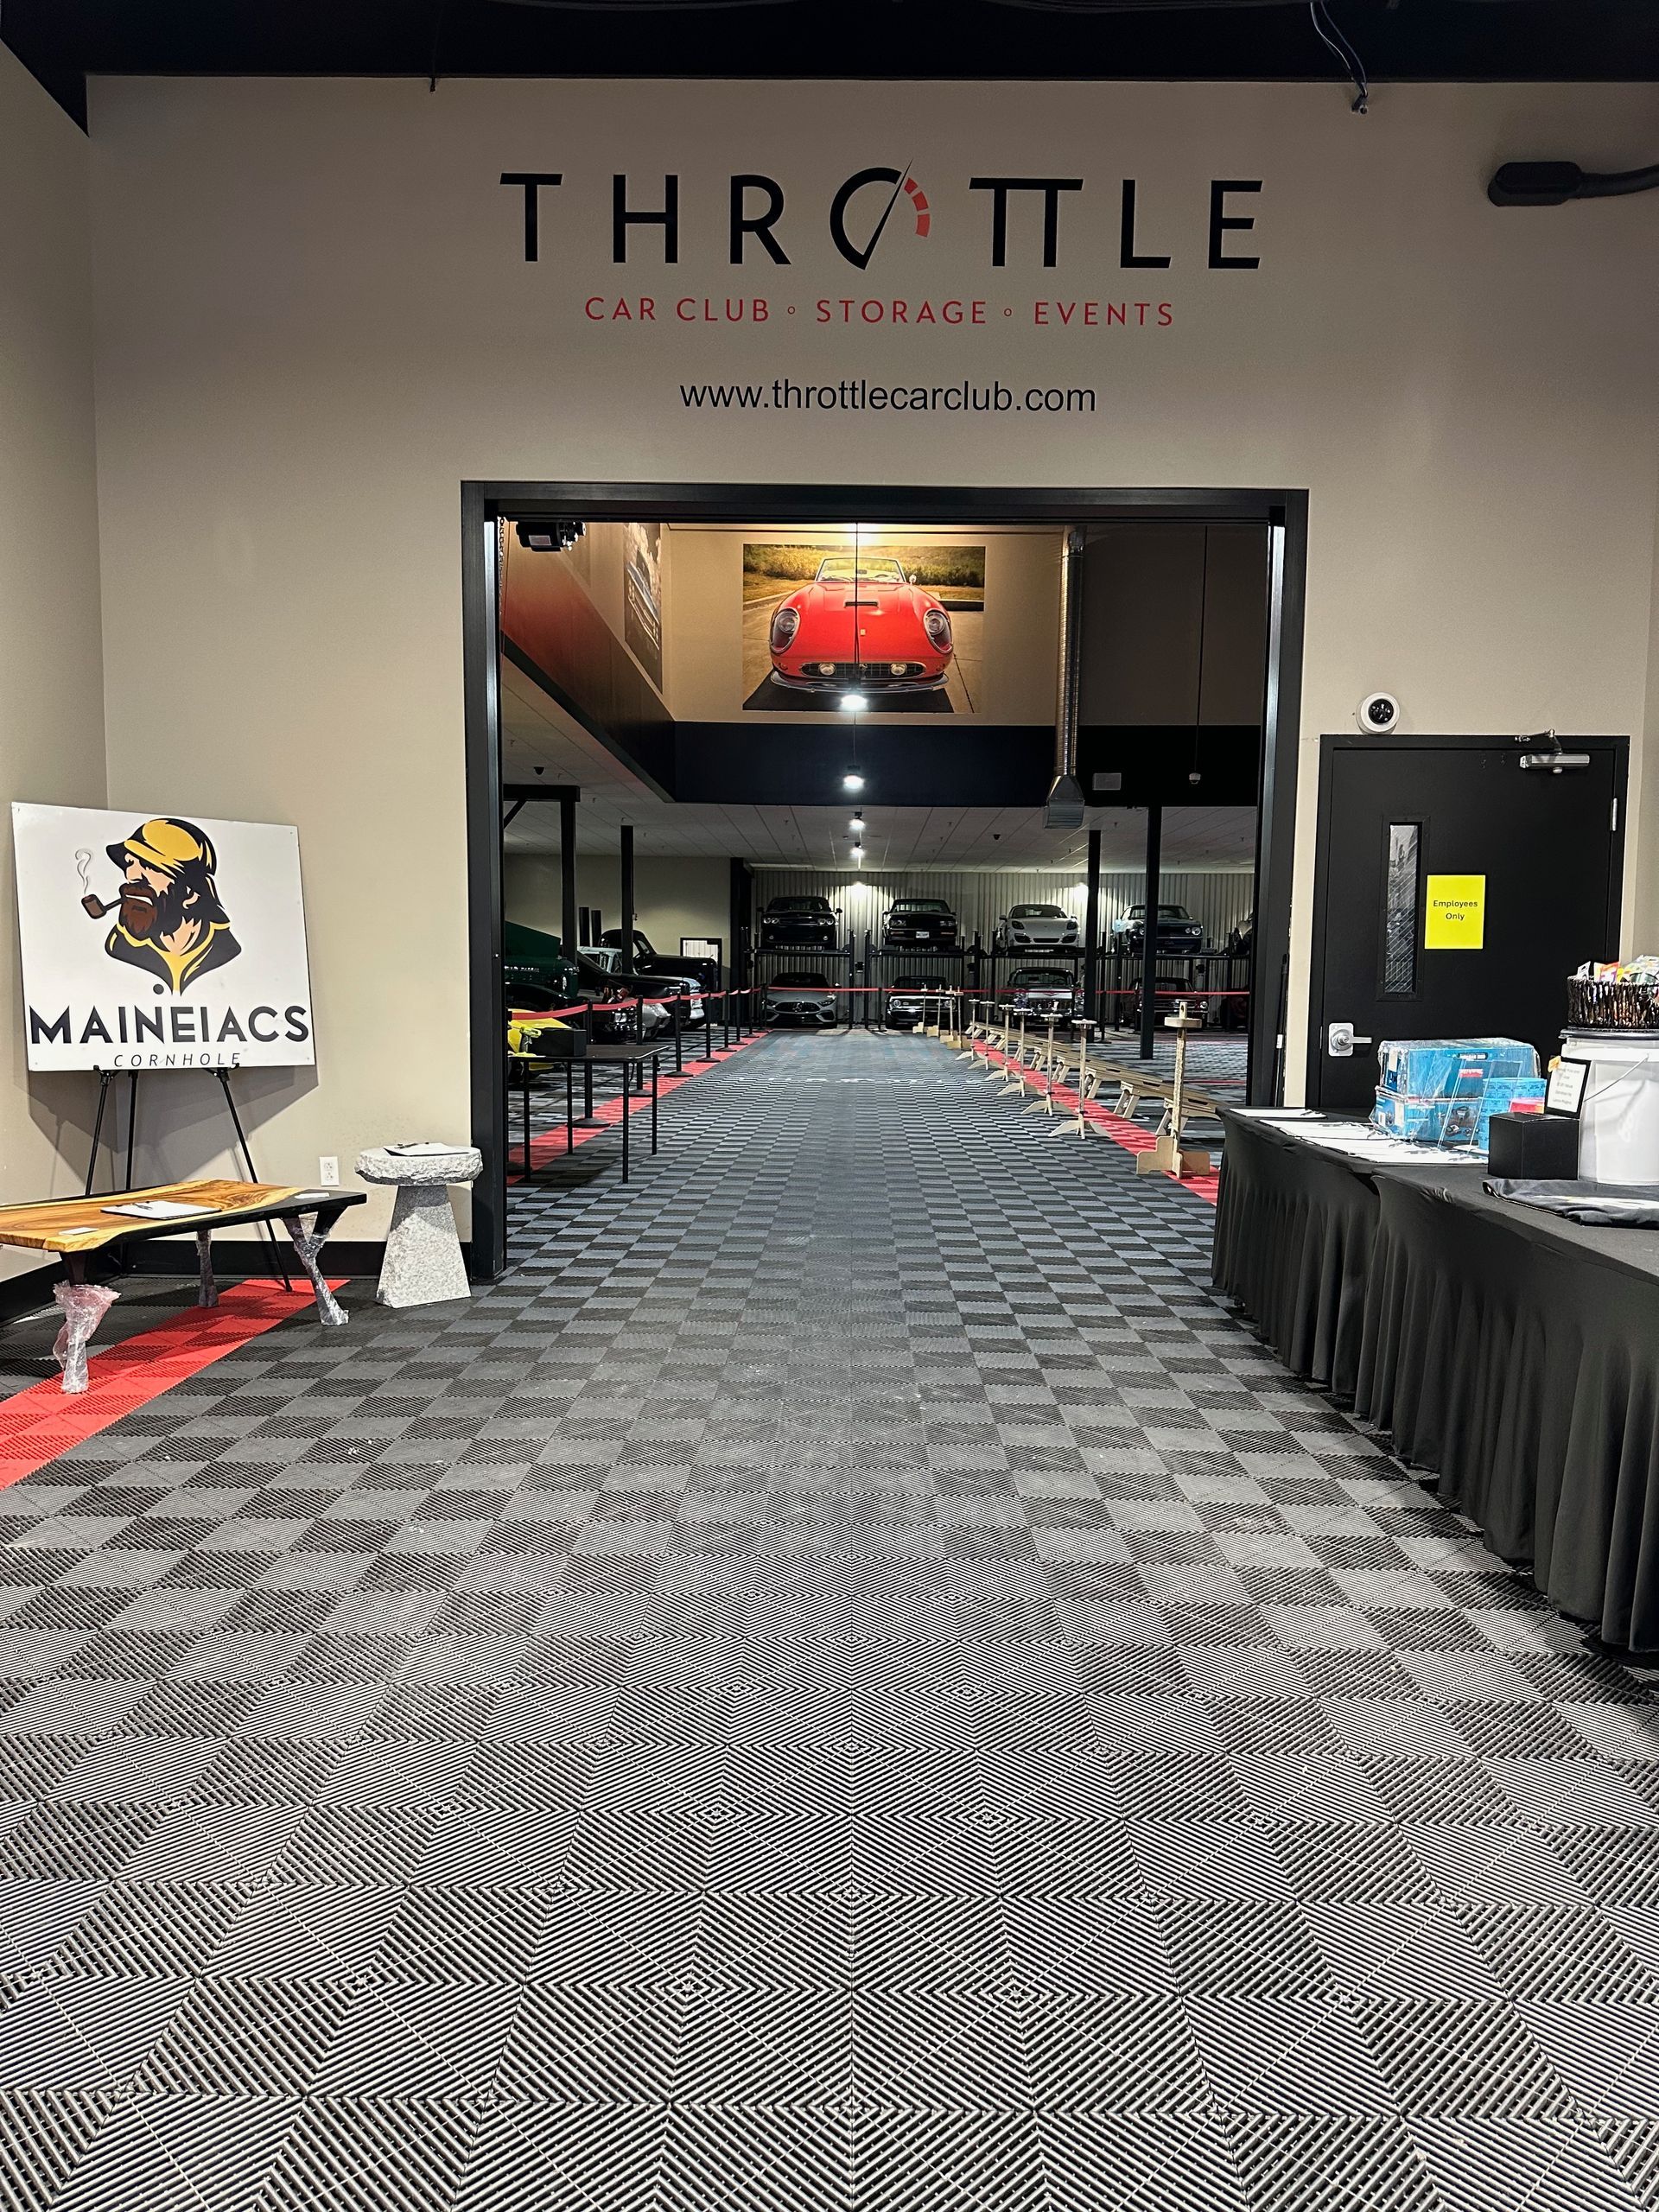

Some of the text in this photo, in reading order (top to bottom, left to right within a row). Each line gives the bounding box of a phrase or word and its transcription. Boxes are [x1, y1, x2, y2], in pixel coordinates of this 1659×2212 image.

[499, 161, 1263, 270] THROTTLE
[584, 296, 1173, 327] CAR CLUB STORAGE EVENTS
[679, 378, 1096, 412] www.throttlecarclub.com
[1433, 899, 1478, 908] Employees
[1446, 912, 1465, 921] Only
[29, 1005, 309, 1045] MAINEIACS
[114, 1052, 240, 1067] CORNHOLE
